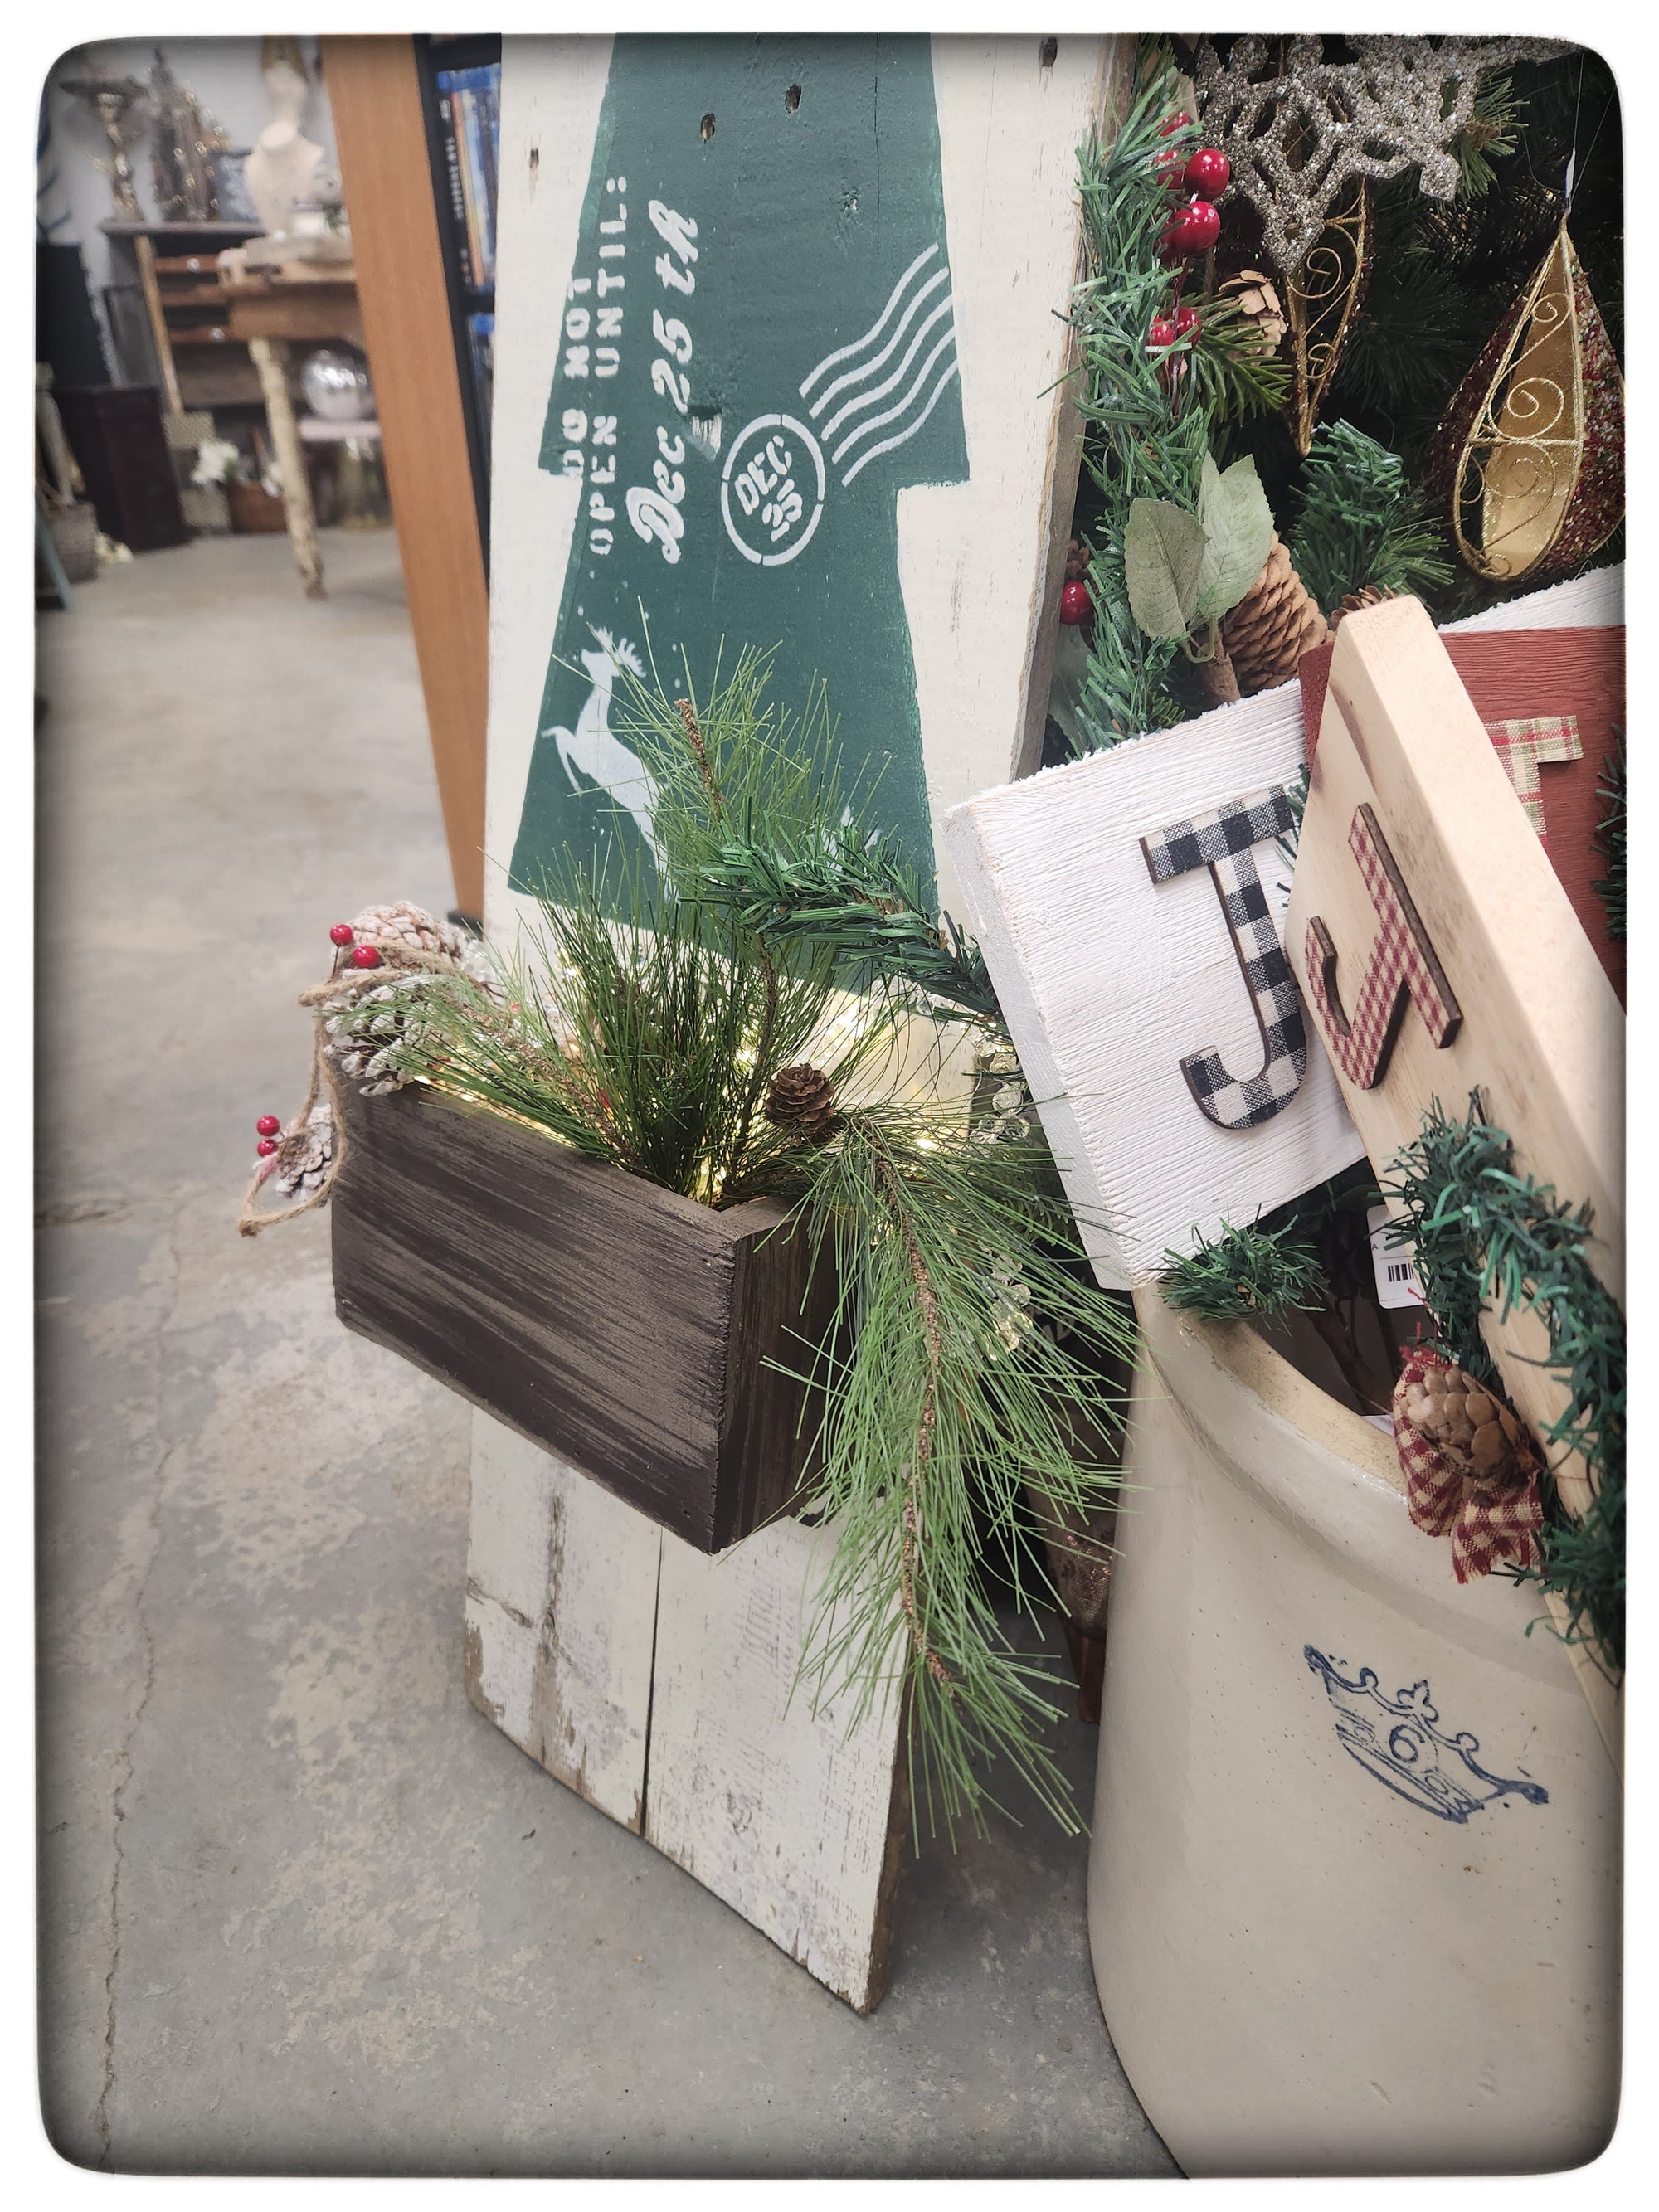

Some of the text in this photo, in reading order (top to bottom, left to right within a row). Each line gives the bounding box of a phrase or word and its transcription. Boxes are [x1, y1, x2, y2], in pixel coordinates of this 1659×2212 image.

[562, 273, 591, 476] DO NOT
[590, 176, 627, 555] OPEN UNTIL:
[625, 199, 699, 564] Dec 25 th
[734, 435, 792, 515] DEC
[1139, 784, 1309, 1130] J
[1388, 1723, 1425, 1764] 6
